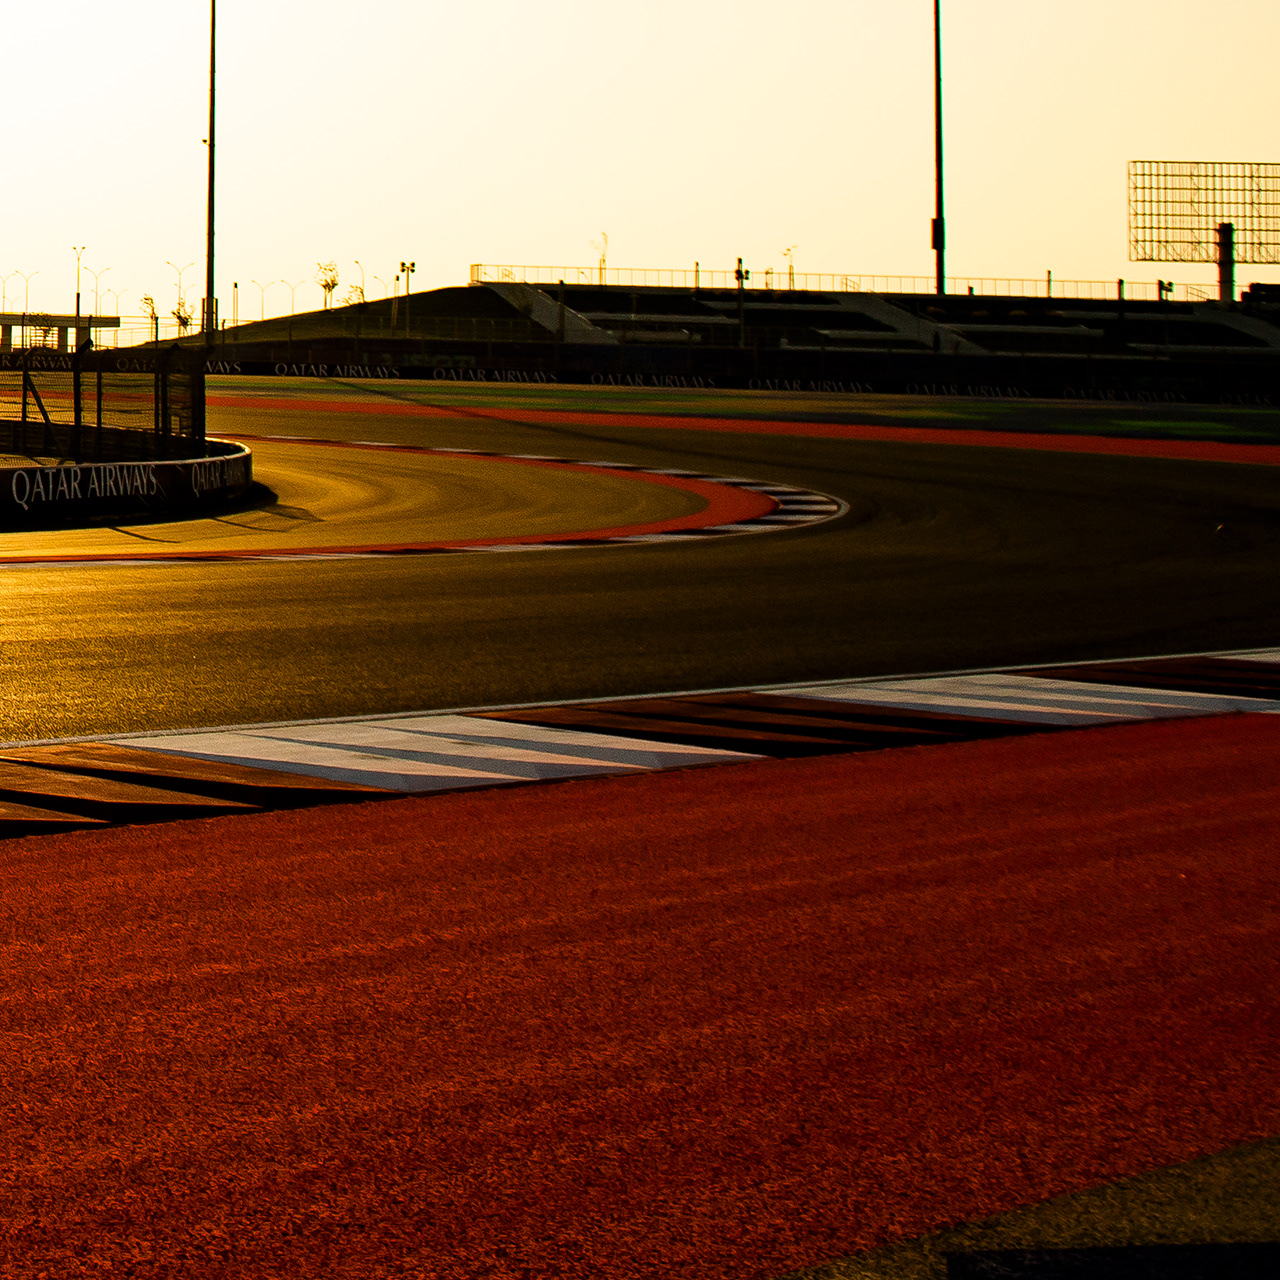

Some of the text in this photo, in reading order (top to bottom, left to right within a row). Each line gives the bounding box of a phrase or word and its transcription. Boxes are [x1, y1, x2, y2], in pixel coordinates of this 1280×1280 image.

[15, 356, 73, 369] AIRWAY
[274, 363, 400, 379] QATAR AIRWAYS
[433, 368, 559, 383] QATAR AIRWAYS
[590, 372, 716, 387] QATAR AIRWAYS
[748, 378, 874, 393] QATAR AIRWAYS
[906, 382, 1031, 398] QATAR AIRWAYS
[1064, 386, 1117, 401] QATAR
[192, 461, 221, 498] QATAR
[11, 465, 157, 511] QATAR AIRWAYS
